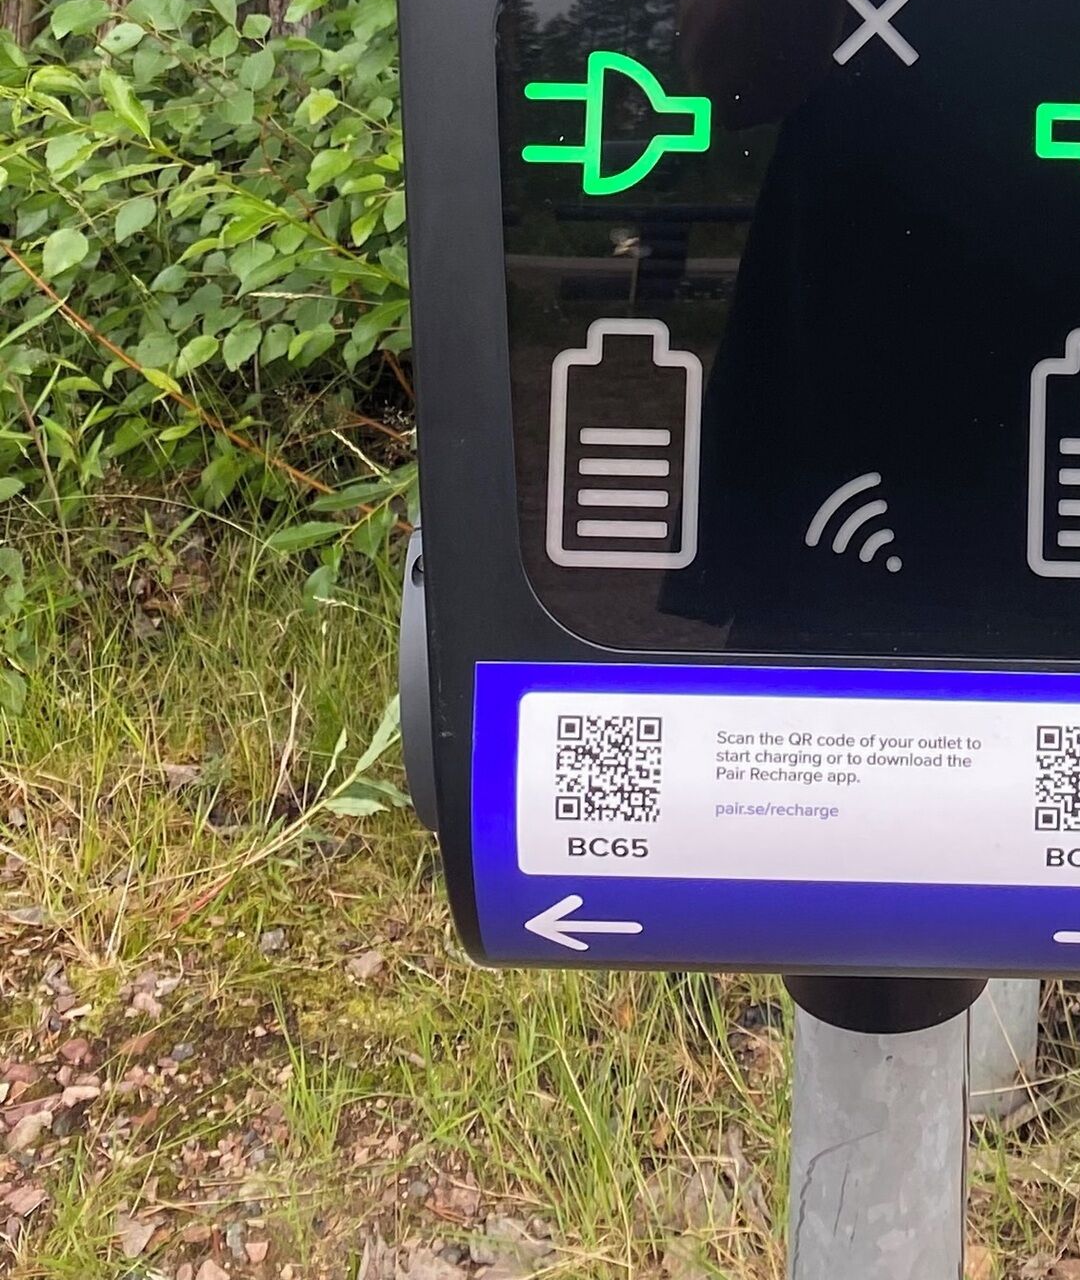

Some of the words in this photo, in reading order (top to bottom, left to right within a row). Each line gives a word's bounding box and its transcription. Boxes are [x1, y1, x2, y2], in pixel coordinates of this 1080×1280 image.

[716, 730, 755, 746] Scan
[758, 731, 785, 746] the
[788, 731, 813, 747] QR
[816, 732, 856, 748] code
[859, 733, 877, 748] of
[878, 736, 915, 752] your
[917, 735, 963, 750] outlet
[965, 736, 982, 751] to
[715, 749, 751, 763] start
[754, 749, 822, 768] charging
[826, 753, 844, 765] or
[846, 751, 863, 766] to
[865, 751, 943, 768] download
[946, 753, 973, 769] the
[715, 765, 746, 781] Pair
[749, 766, 824, 786] Recharge
[827, 771, 861, 787] app.
[715, 801, 840, 821] pair.se/recharge
[567, 836, 649, 859] BC65
